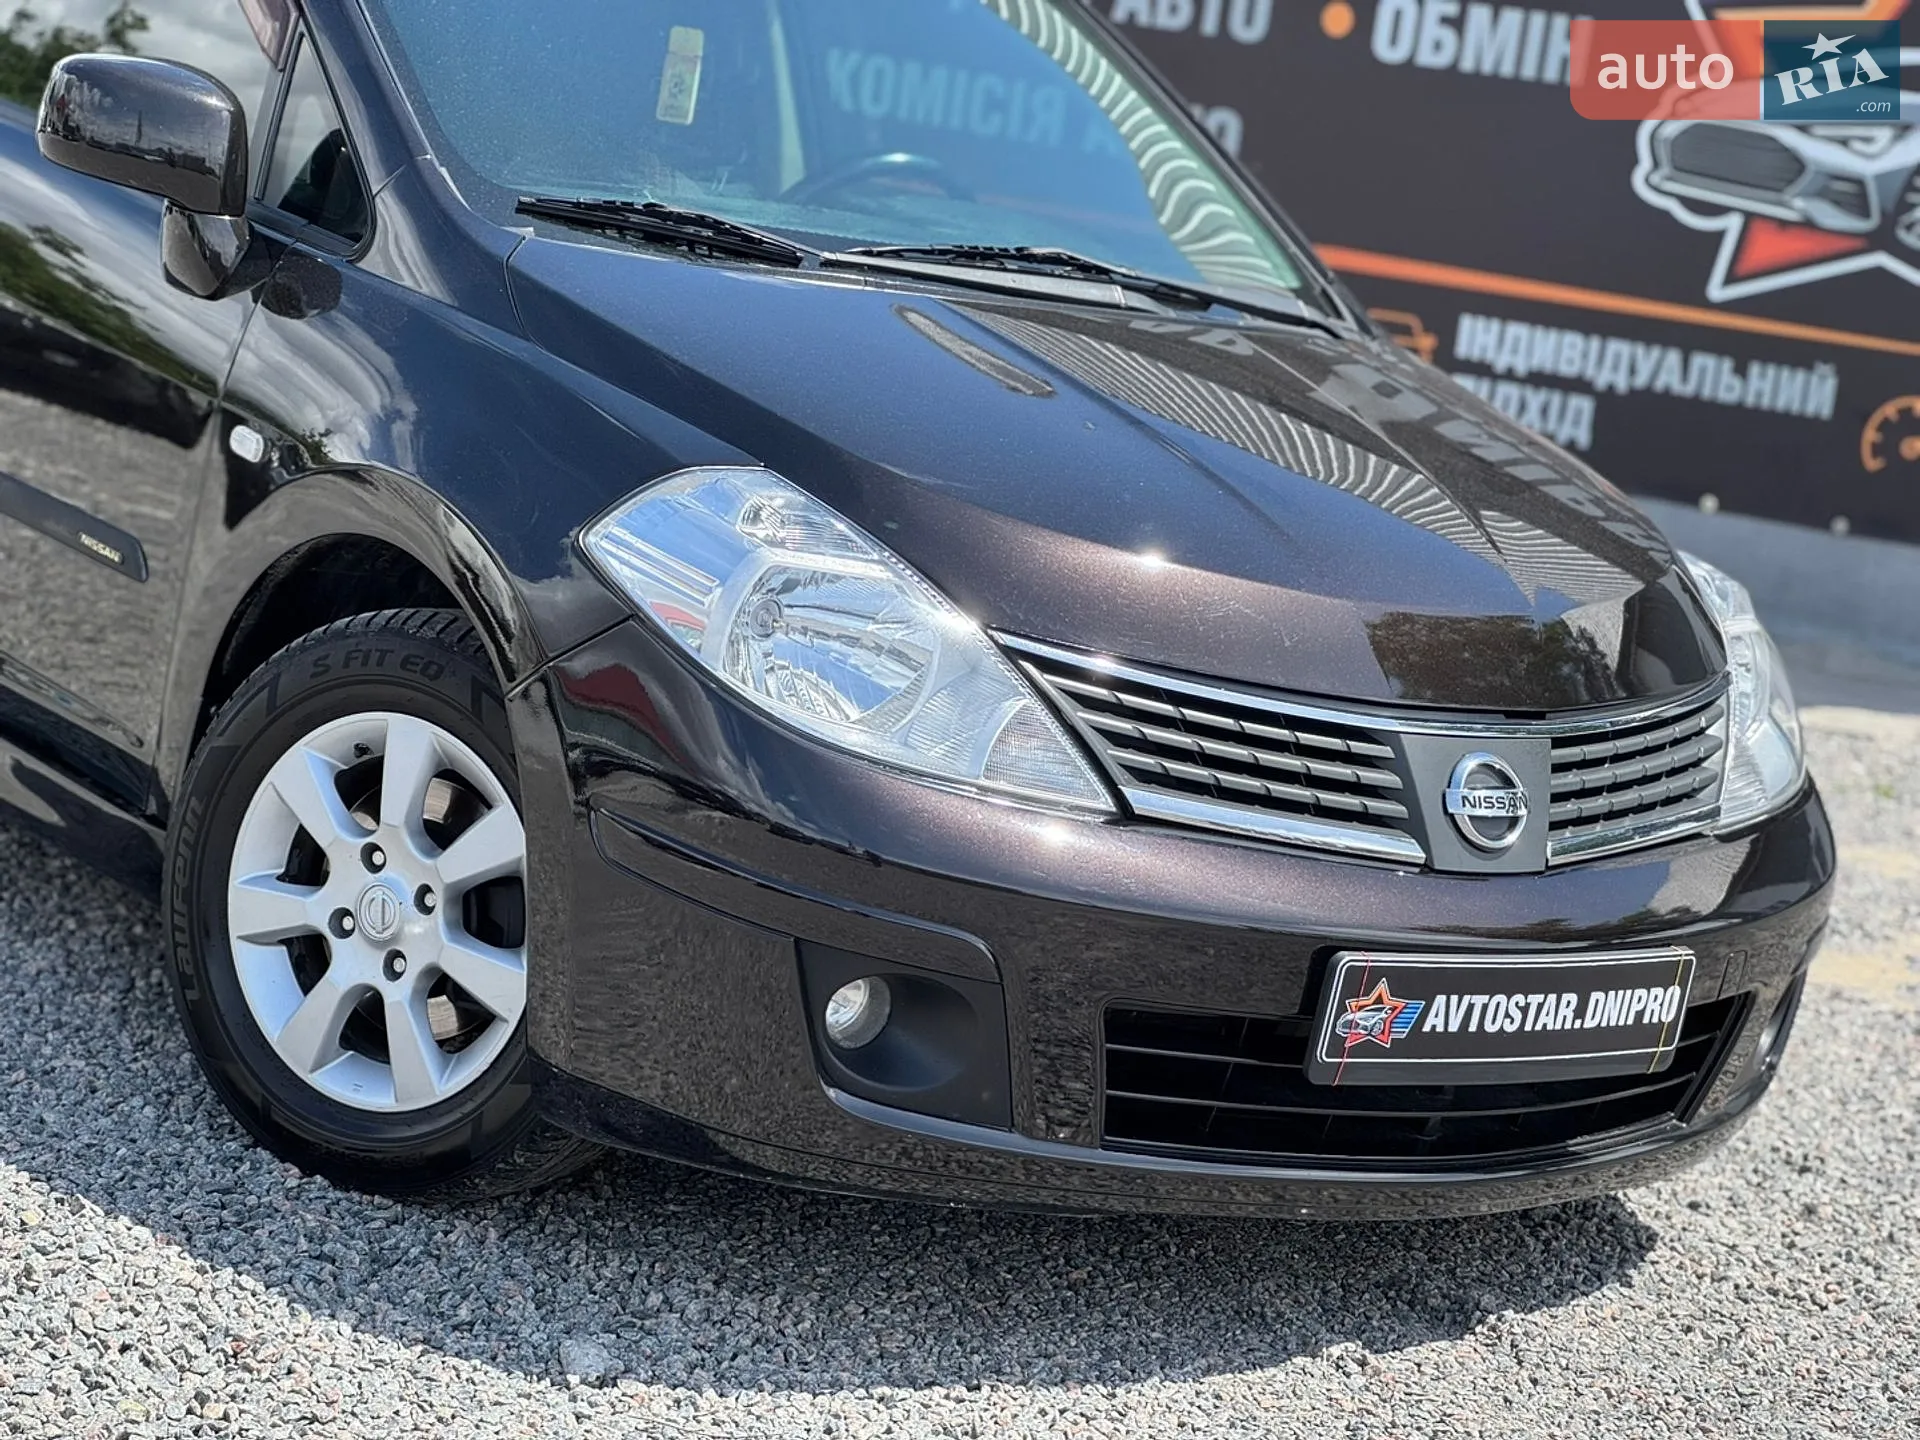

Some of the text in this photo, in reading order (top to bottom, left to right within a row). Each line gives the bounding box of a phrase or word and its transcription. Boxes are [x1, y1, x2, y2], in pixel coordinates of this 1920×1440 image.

[1371, 0, 1596, 87] ОБМІН
[826, 46, 1066, 147] КОМІСІЯ
[1454, 312, 1838, 420] ІНДИВІДУАЛЬНИЙ
[80, 533, 121, 562] NISSAN
[309, 653, 332, 679] S
[341, 648, 395, 670] FIT
[1461, 792, 1528, 812] NISSAN
[1422, 985, 1682, 1033] AVTOSTAR.DNIPRO
